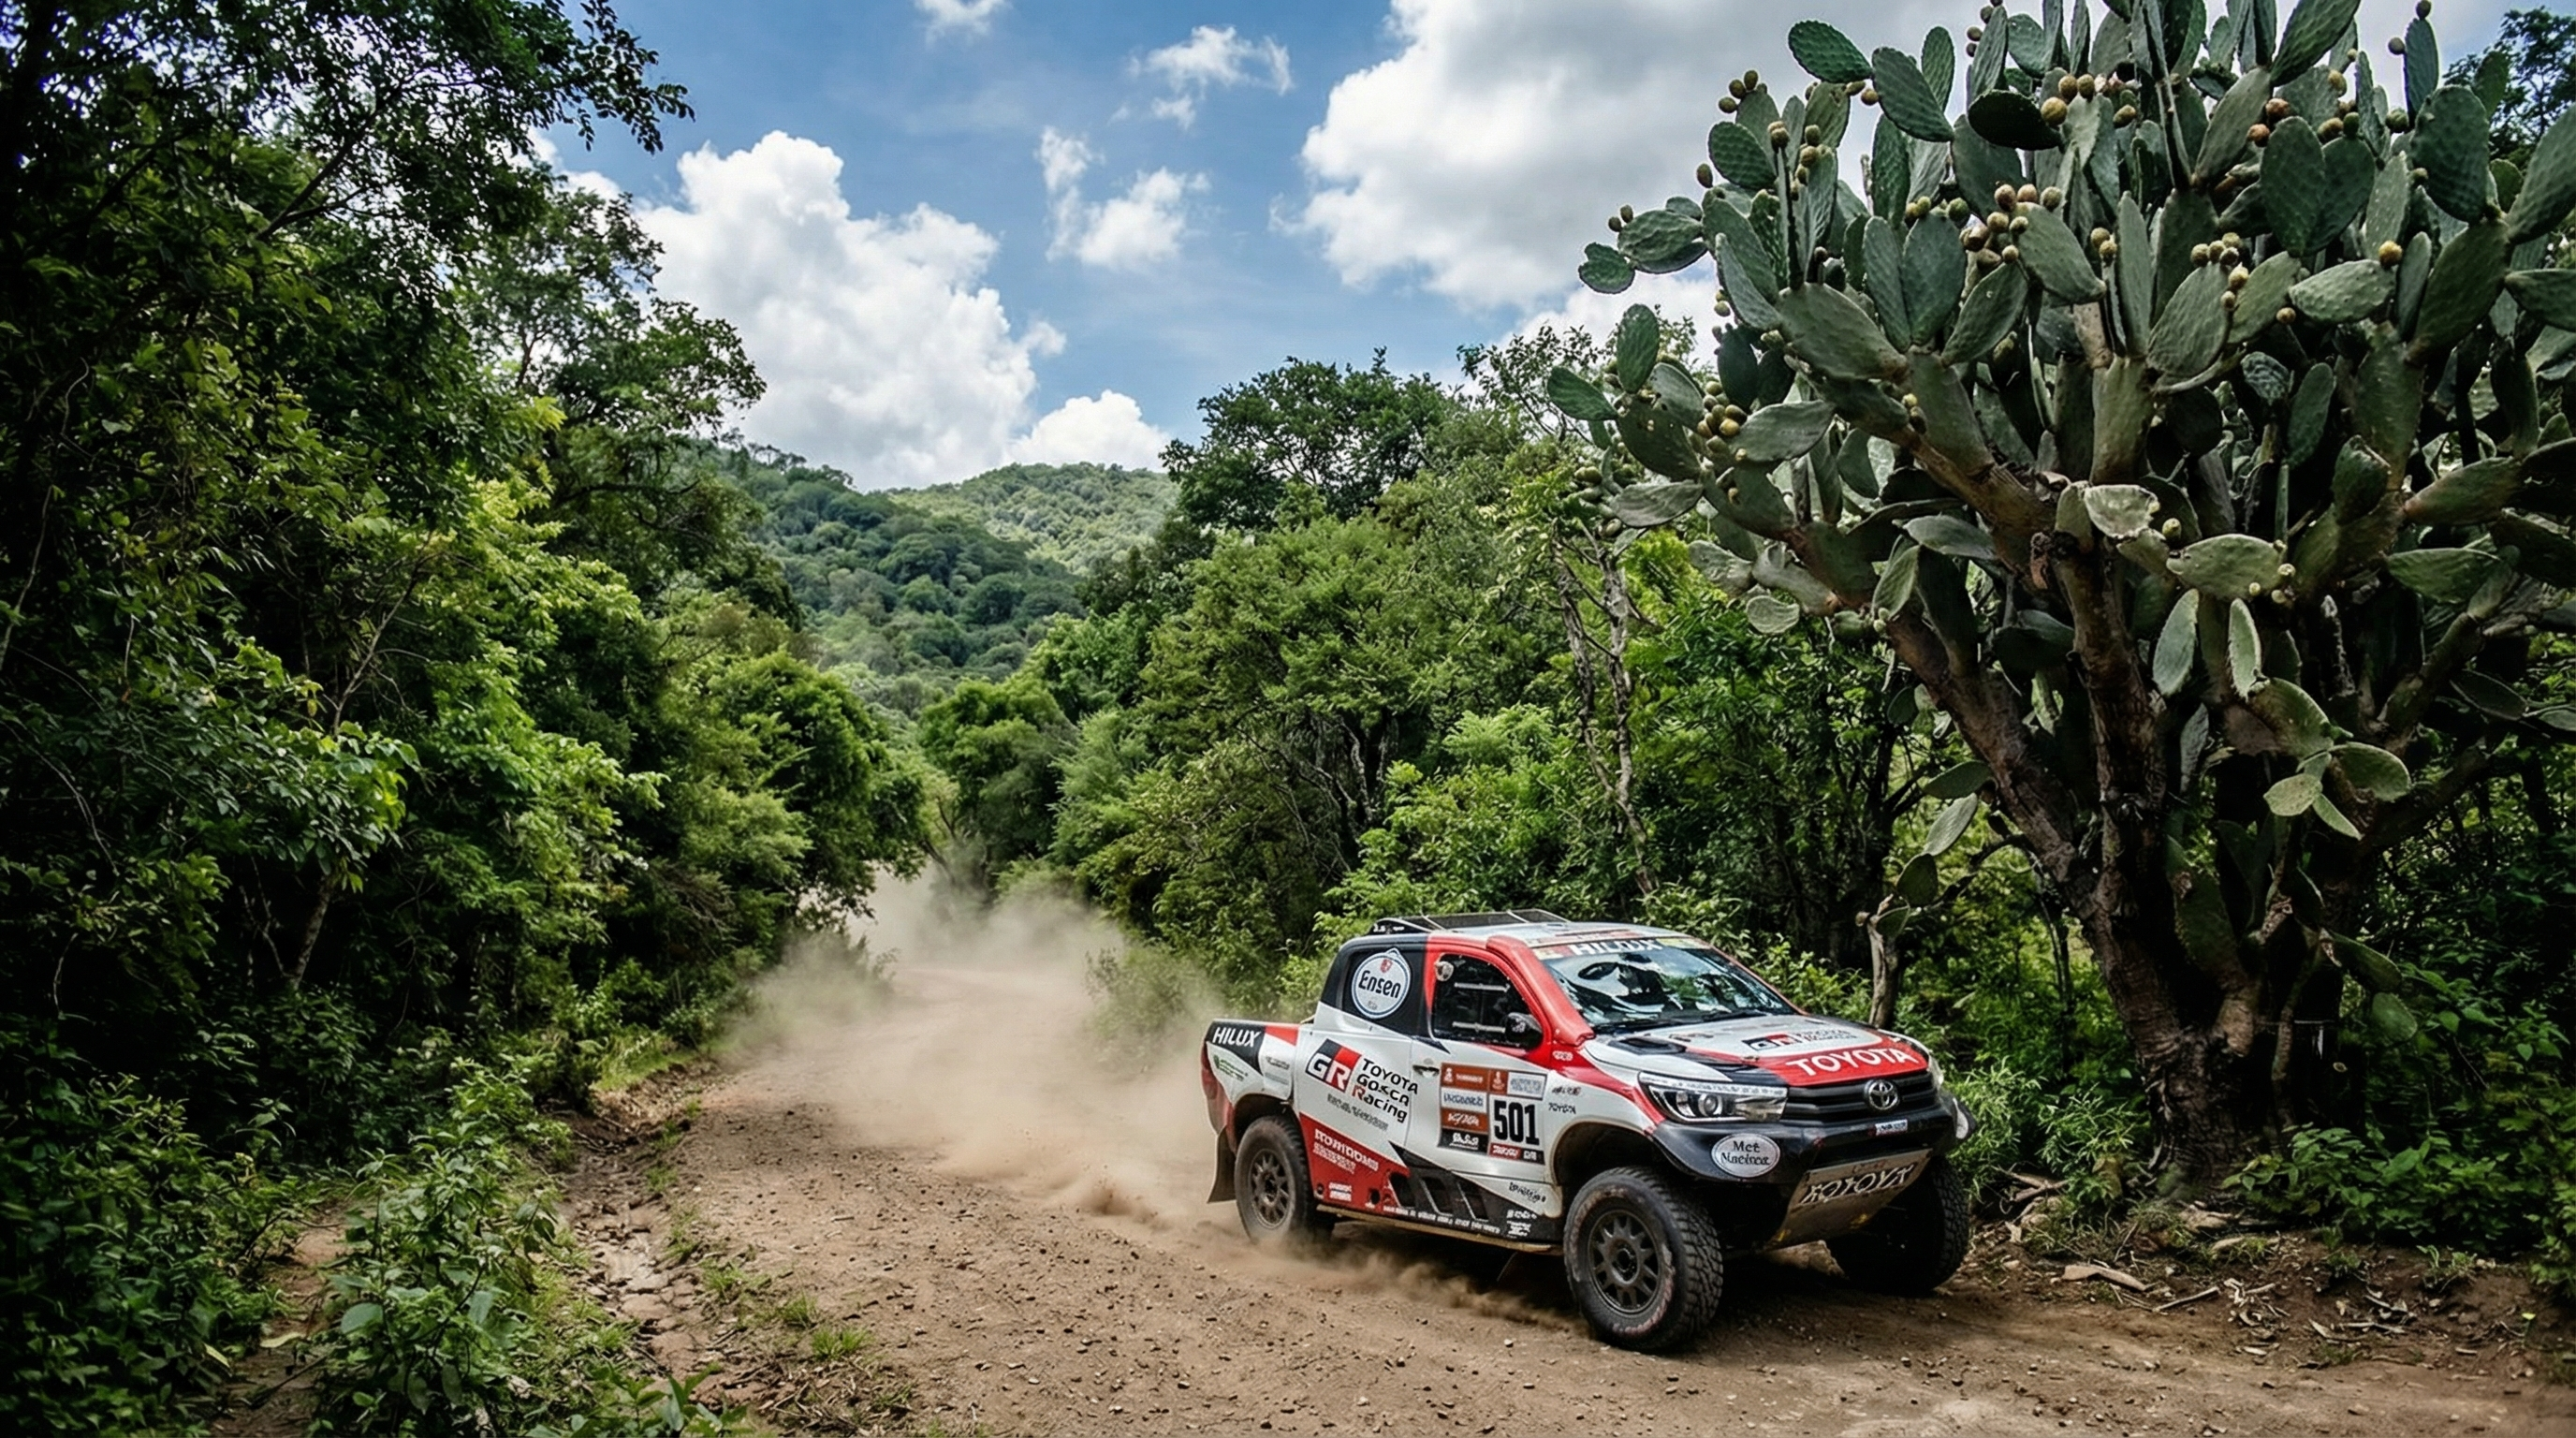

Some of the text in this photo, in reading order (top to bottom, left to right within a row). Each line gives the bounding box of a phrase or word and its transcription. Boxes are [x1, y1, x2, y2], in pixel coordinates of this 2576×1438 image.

[1358, 970, 1401, 999] Ensen
[1212, 1026, 1262, 1048] HILUX
[1307, 1051, 1352, 1091] GR
[1362, 1058, 1419, 1095] TOYOTA
[1785, 1048, 1920, 1077] TOYOTA
[1352, 1085, 1408, 1123] Racing
[1494, 1100, 1540, 1146] 501
